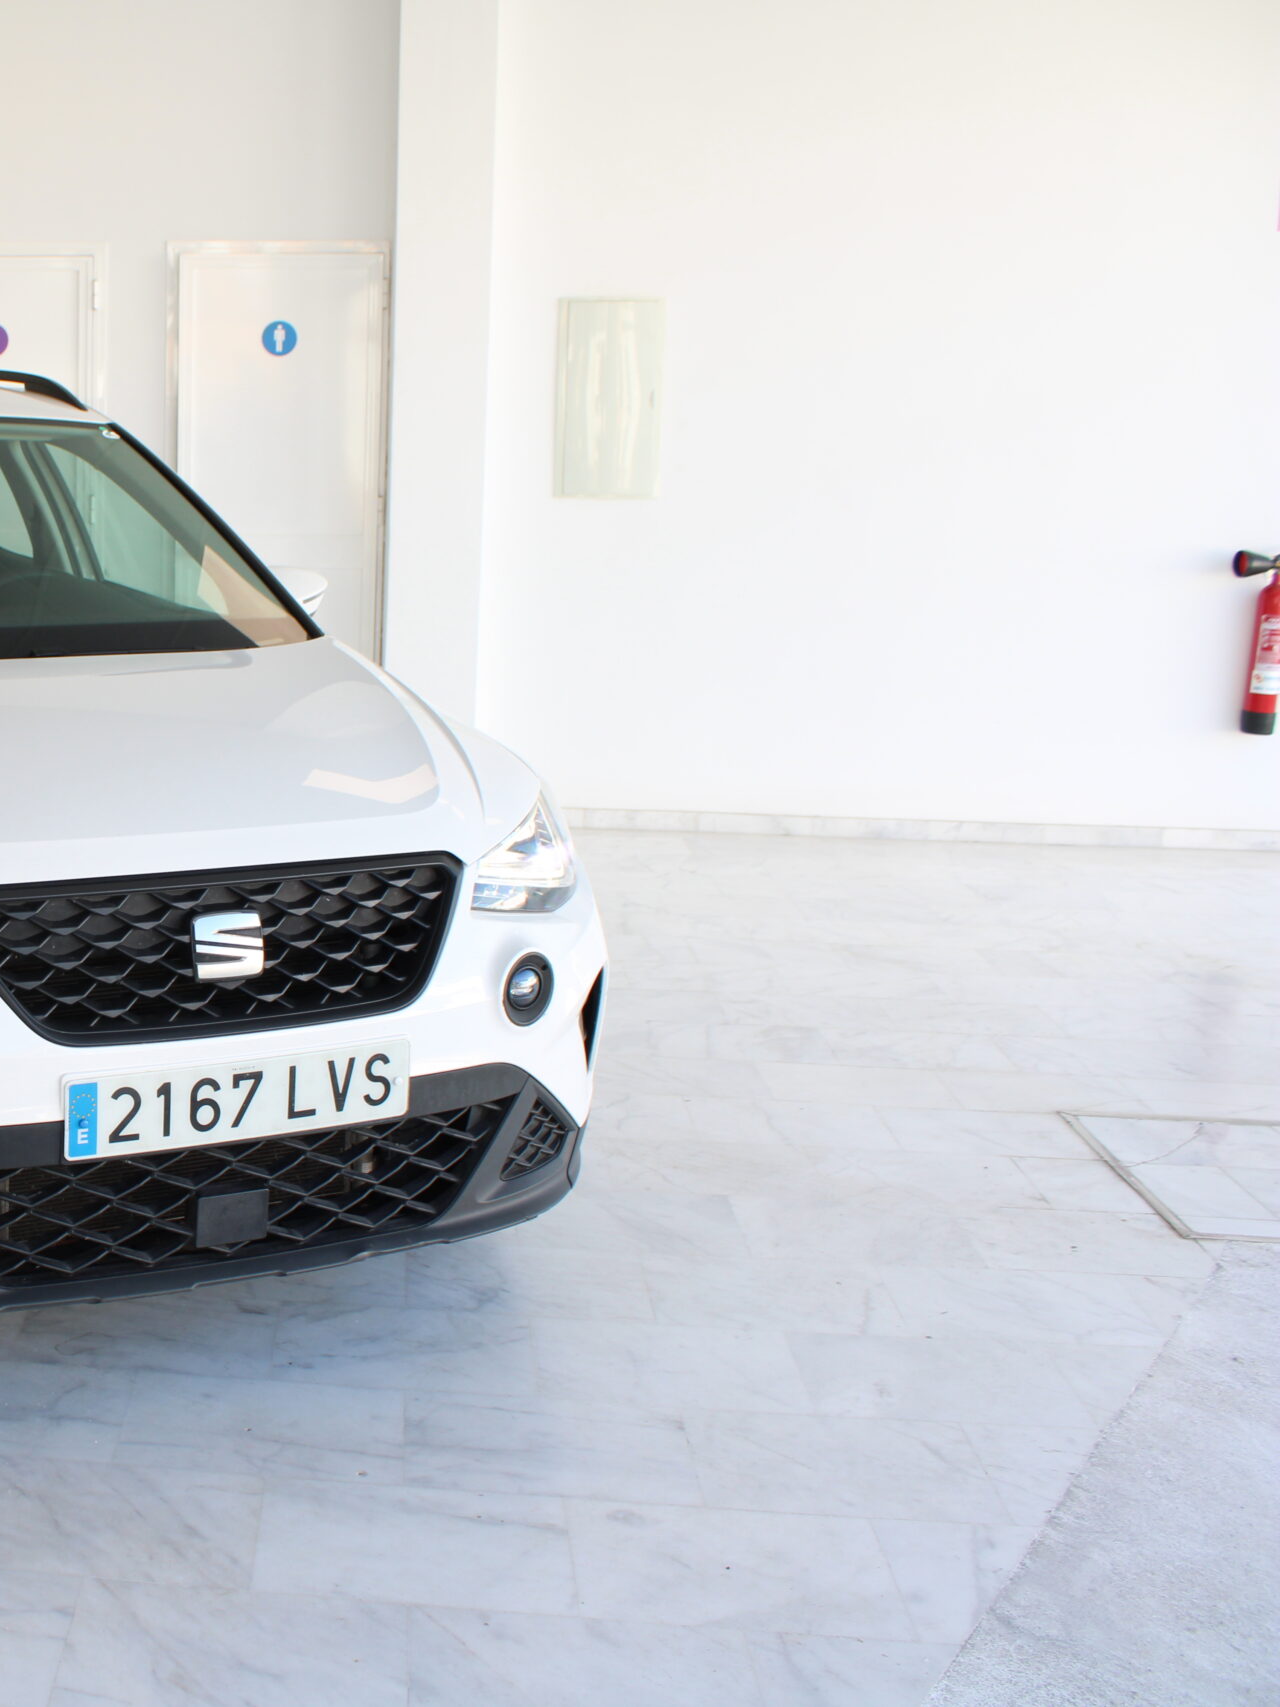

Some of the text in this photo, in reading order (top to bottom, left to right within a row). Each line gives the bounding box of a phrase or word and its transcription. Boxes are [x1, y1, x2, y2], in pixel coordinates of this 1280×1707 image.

[108, 1053, 391, 1144] 2167 LVS
[77, 1128, 89, 1145] E
